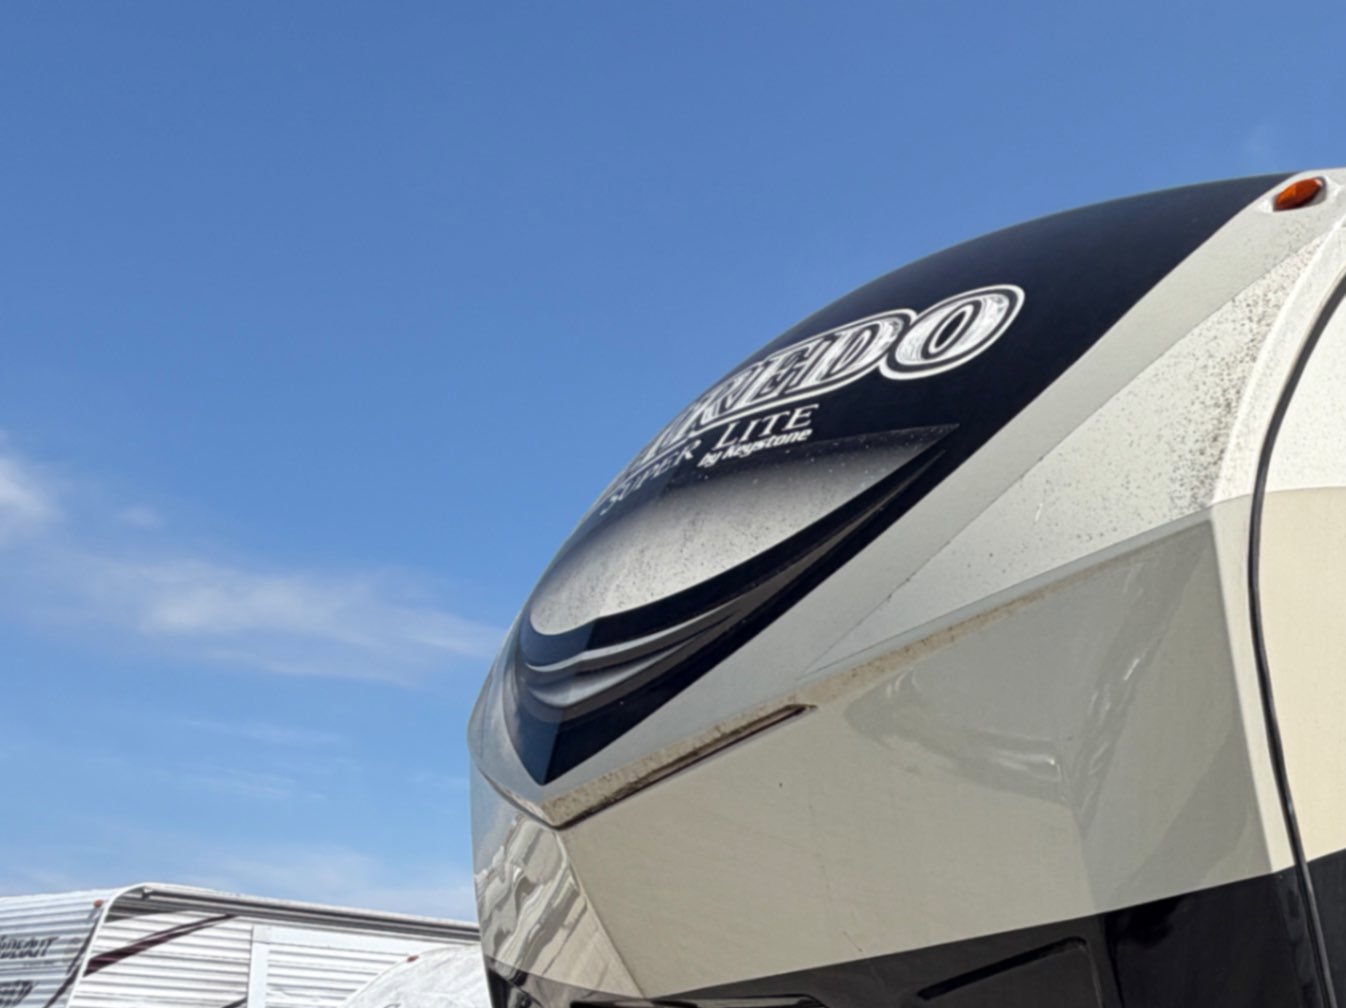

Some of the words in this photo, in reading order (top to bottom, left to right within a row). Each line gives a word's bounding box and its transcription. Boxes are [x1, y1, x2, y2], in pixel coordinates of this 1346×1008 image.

[600, 439, 701, 516] SUPER
[711, 403, 820, 452] LITE
[697, 450, 723, 468] by
[722, 429, 813, 459] Keystone
